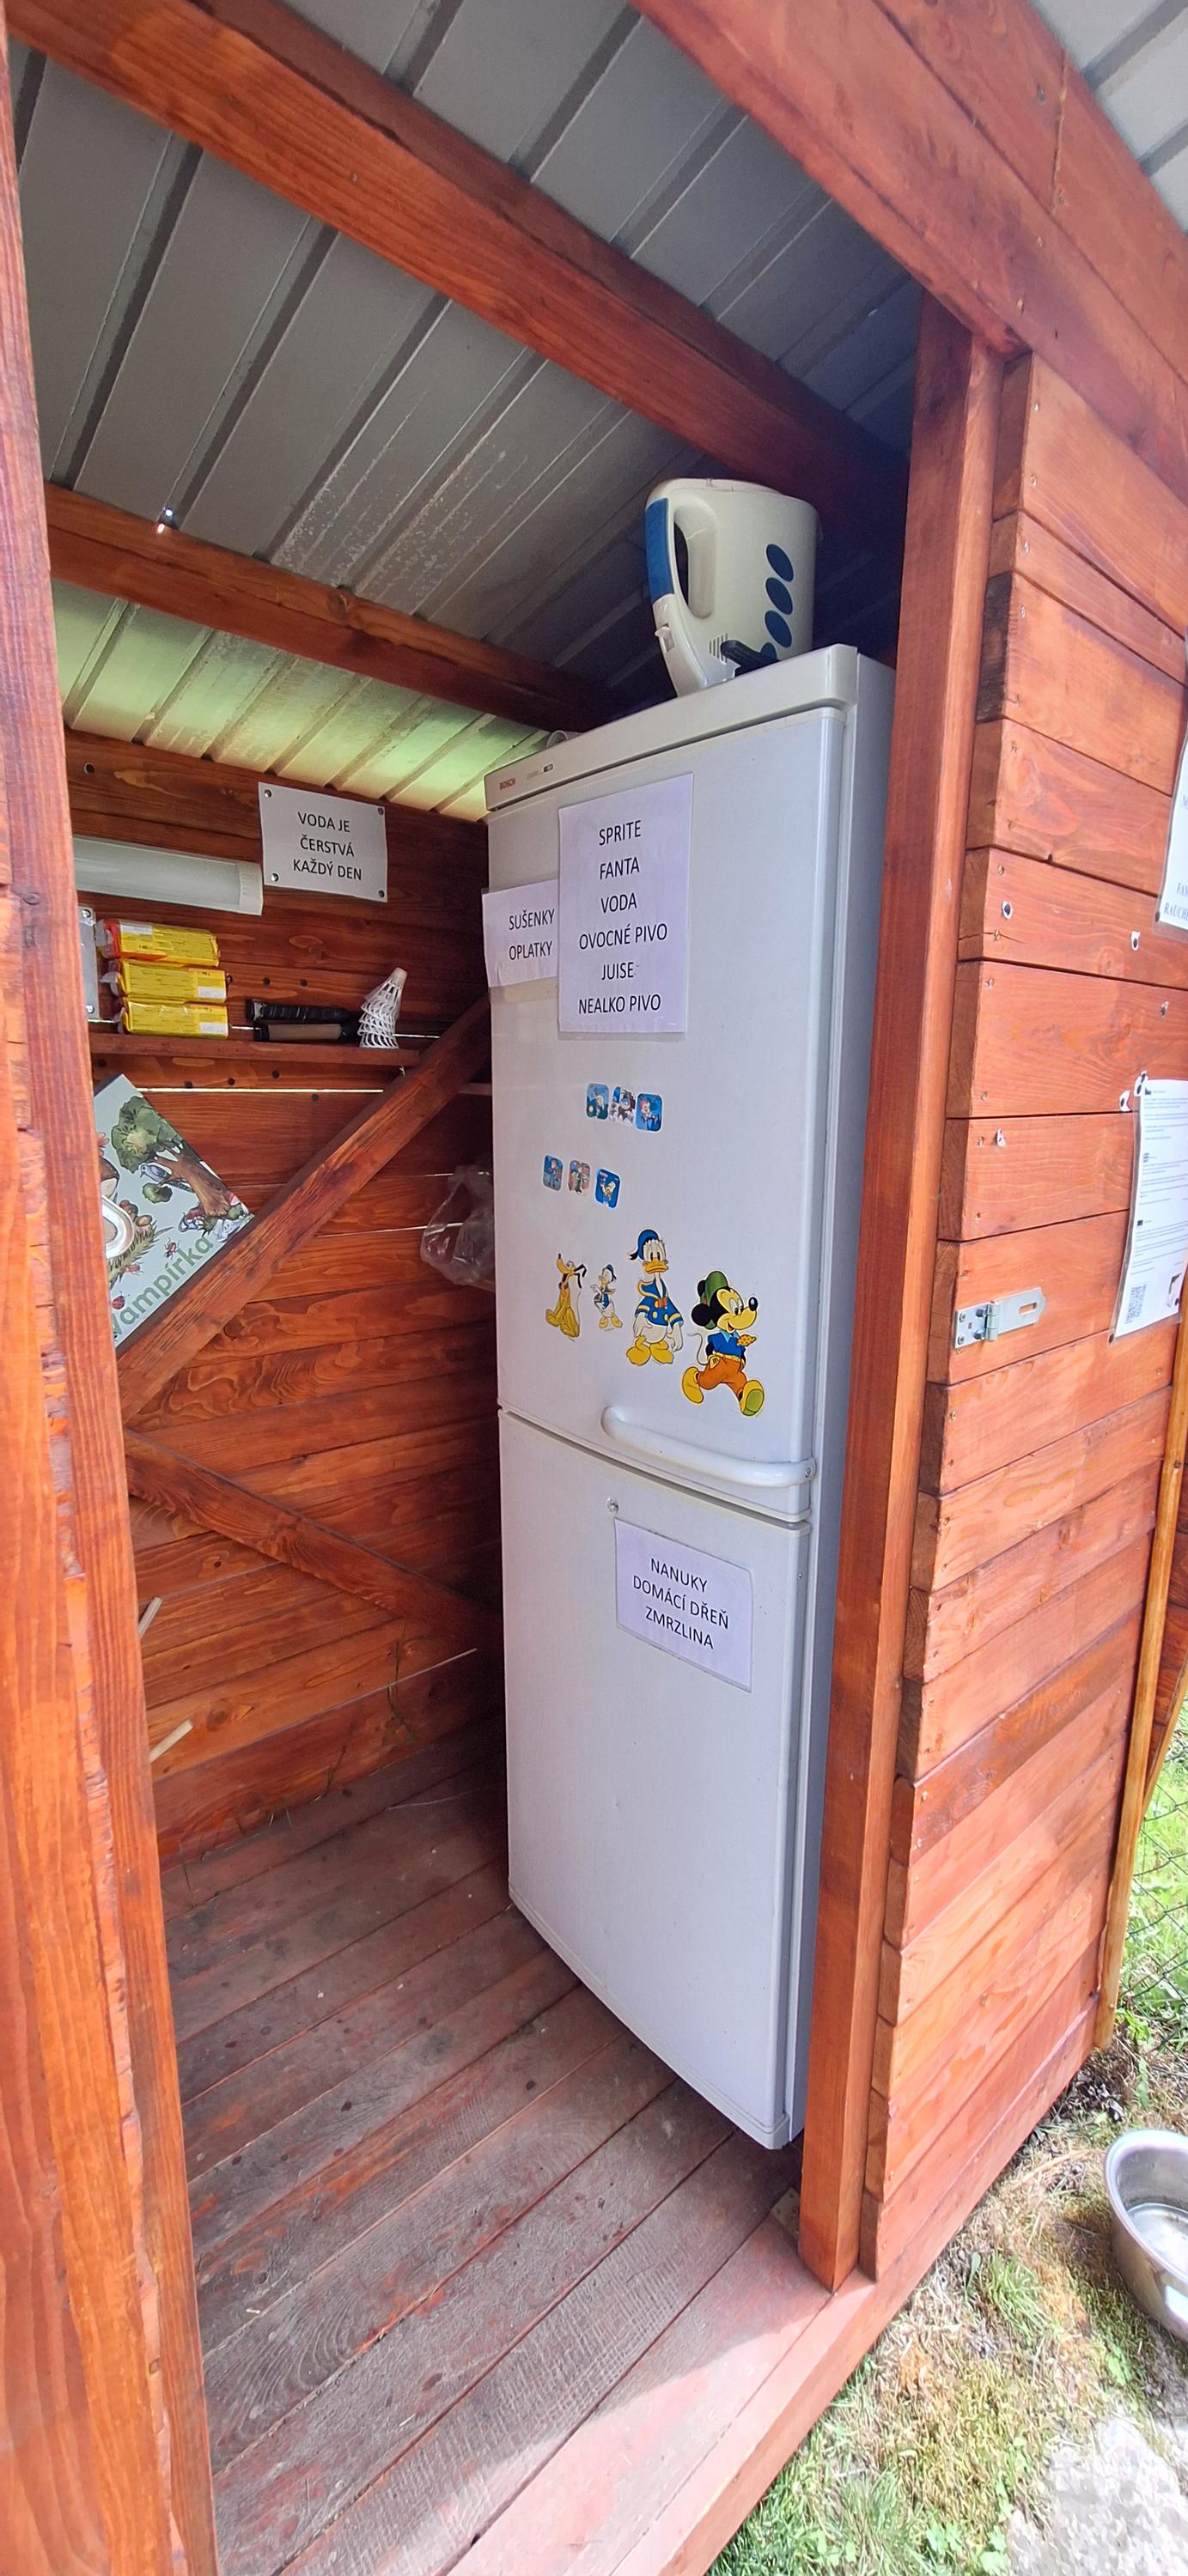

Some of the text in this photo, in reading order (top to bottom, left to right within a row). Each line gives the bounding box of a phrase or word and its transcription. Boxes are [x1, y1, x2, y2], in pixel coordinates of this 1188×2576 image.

[499, 776, 515, 790] BOSCH
[297, 811, 350, 833] VODA JE
[599, 819, 642, 846] SPRITE
[300, 834, 355, 858] ČERSTVÁ
[293, 858, 362, 881] KAŽDÝ DEN
[600, 857, 640, 880] FANTA
[600, 892, 637, 914] VODA
[509, 909, 555, 931] SUŠENKY
[579, 923, 667, 950] OVOCNÉ PIVO
[509, 940, 553, 960] OPLATKY
[601, 962, 634, 981] JUISE
[579, 994, 661, 1014] NEALKO PIVO
[651, 1558, 708, 1593] NANUKY
[633, 1575, 728, 1630] DOMÁCÍ DŘEŇ
[645, 1606, 714, 1649] ZMRZLINA
